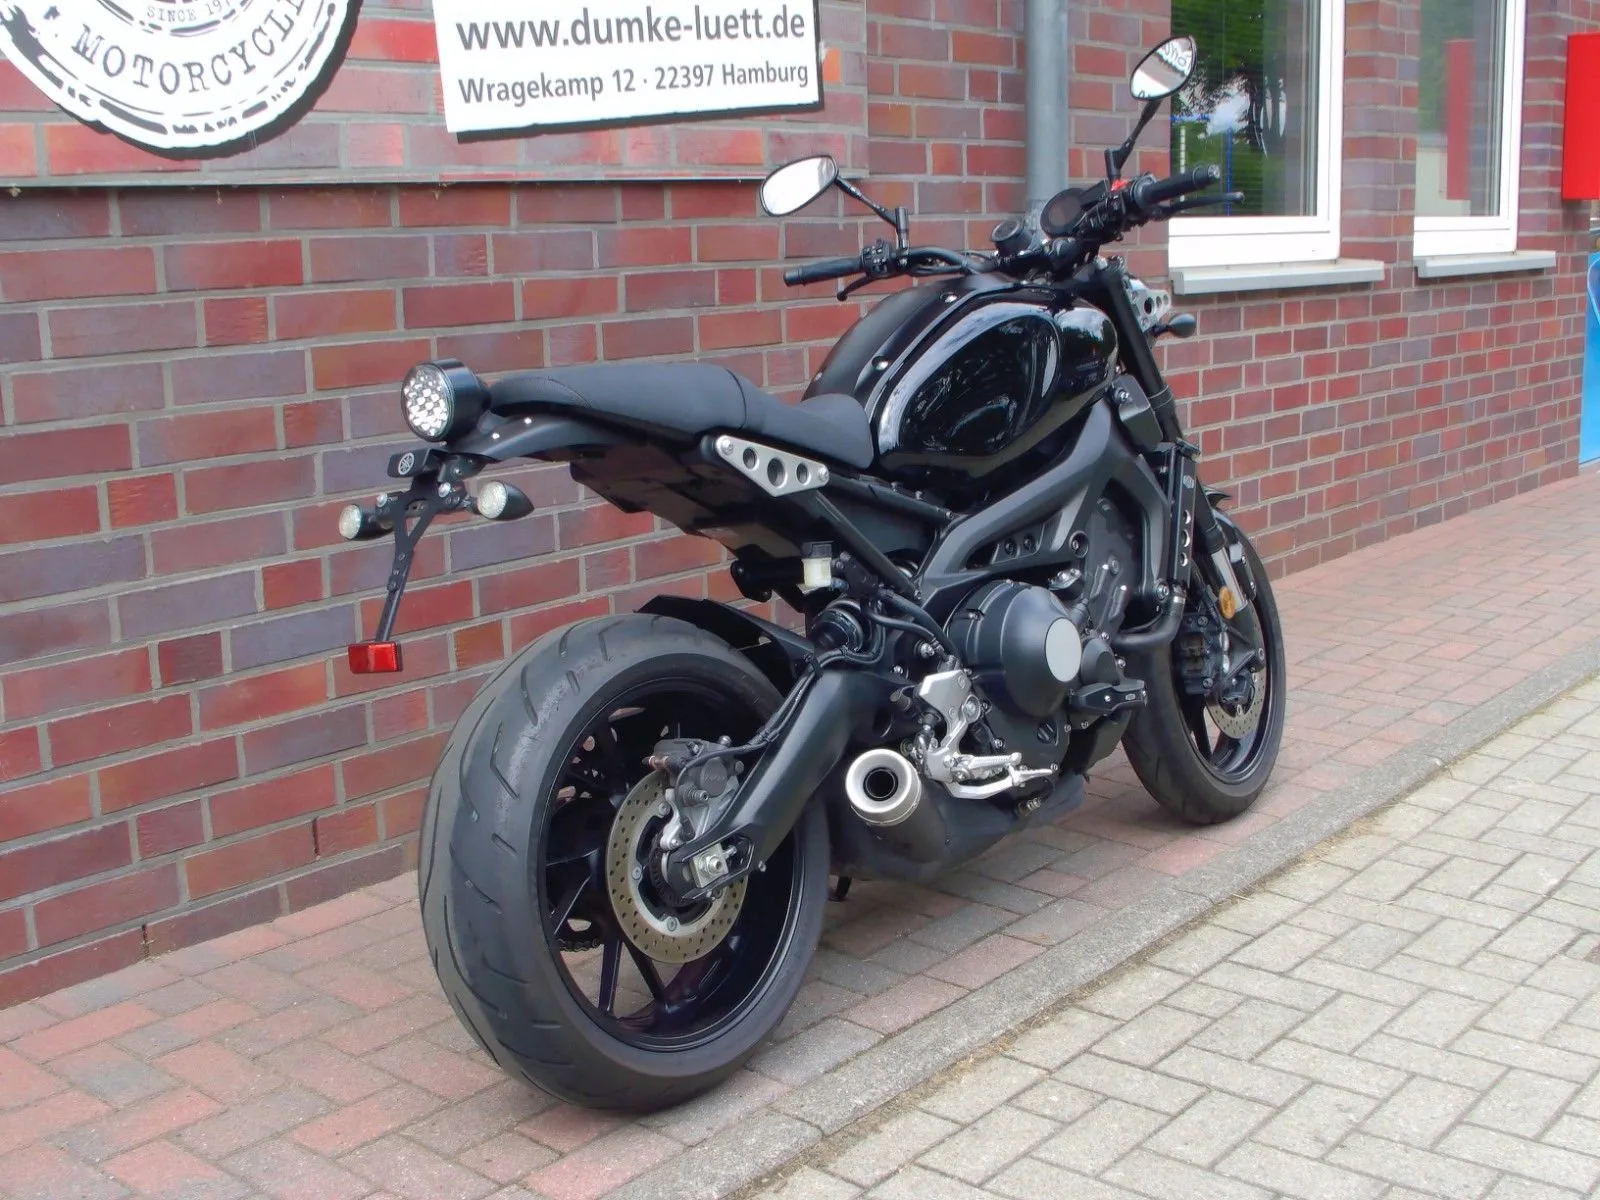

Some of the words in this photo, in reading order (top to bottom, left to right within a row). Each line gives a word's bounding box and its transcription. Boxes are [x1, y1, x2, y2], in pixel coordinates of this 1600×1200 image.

[146, 6, 197, 22] SINCE
[455, 4, 806, 51] www.dumke-luett.de
[457, 72, 605, 108] Wragekamp
[612, 68, 636, 93] 12
[654, 64, 714, 90] 22397
[721, 60, 809, 88] Hamburg
